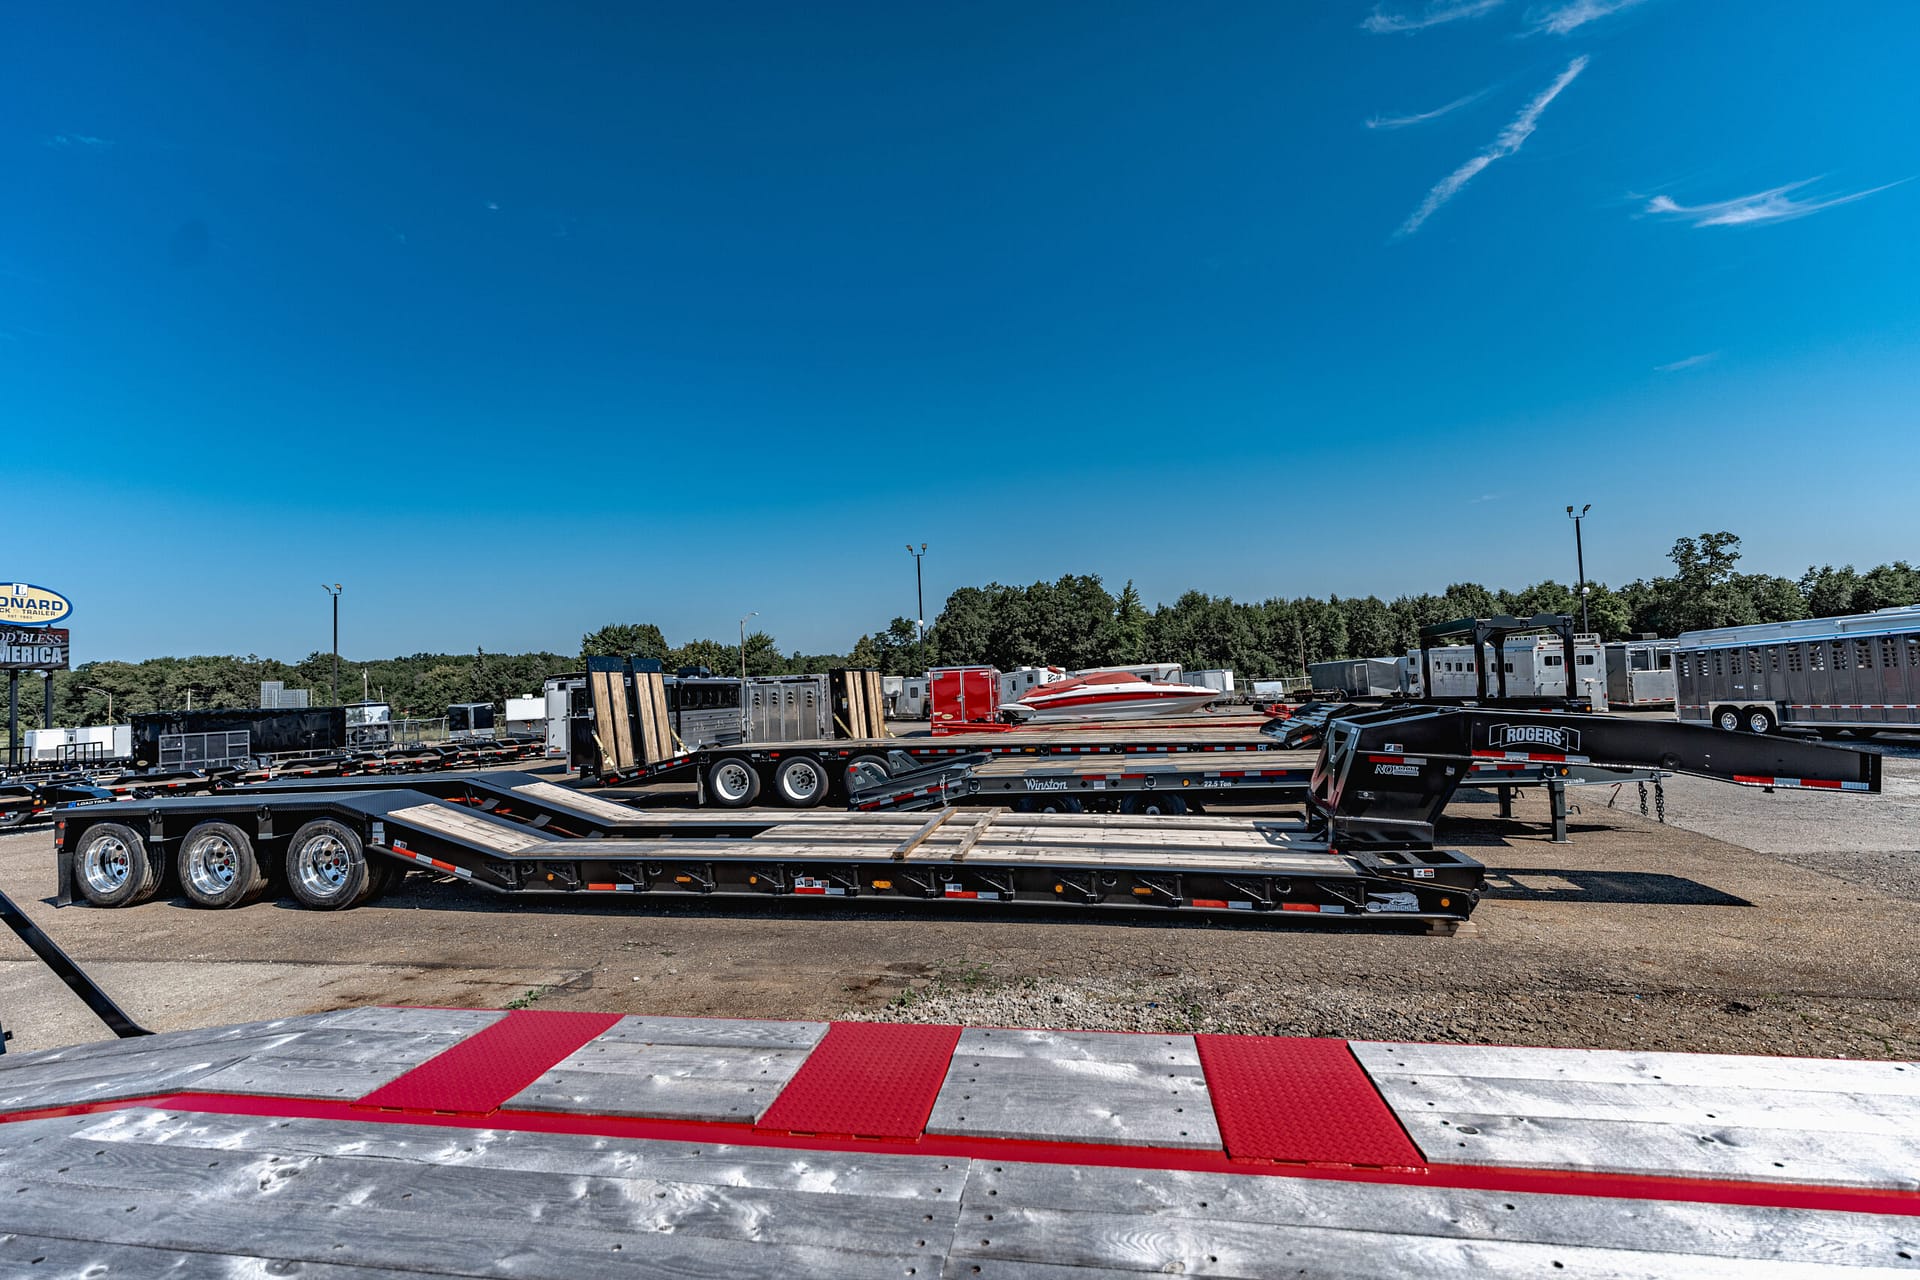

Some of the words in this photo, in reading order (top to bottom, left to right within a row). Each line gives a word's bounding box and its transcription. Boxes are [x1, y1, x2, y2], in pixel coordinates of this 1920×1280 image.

[0, 596, 63, 611] ONARD
[19, 633, 63, 645] BLESS
[1506, 727, 1562, 746] ROGERS
[1023, 778, 1068, 791] Winston
